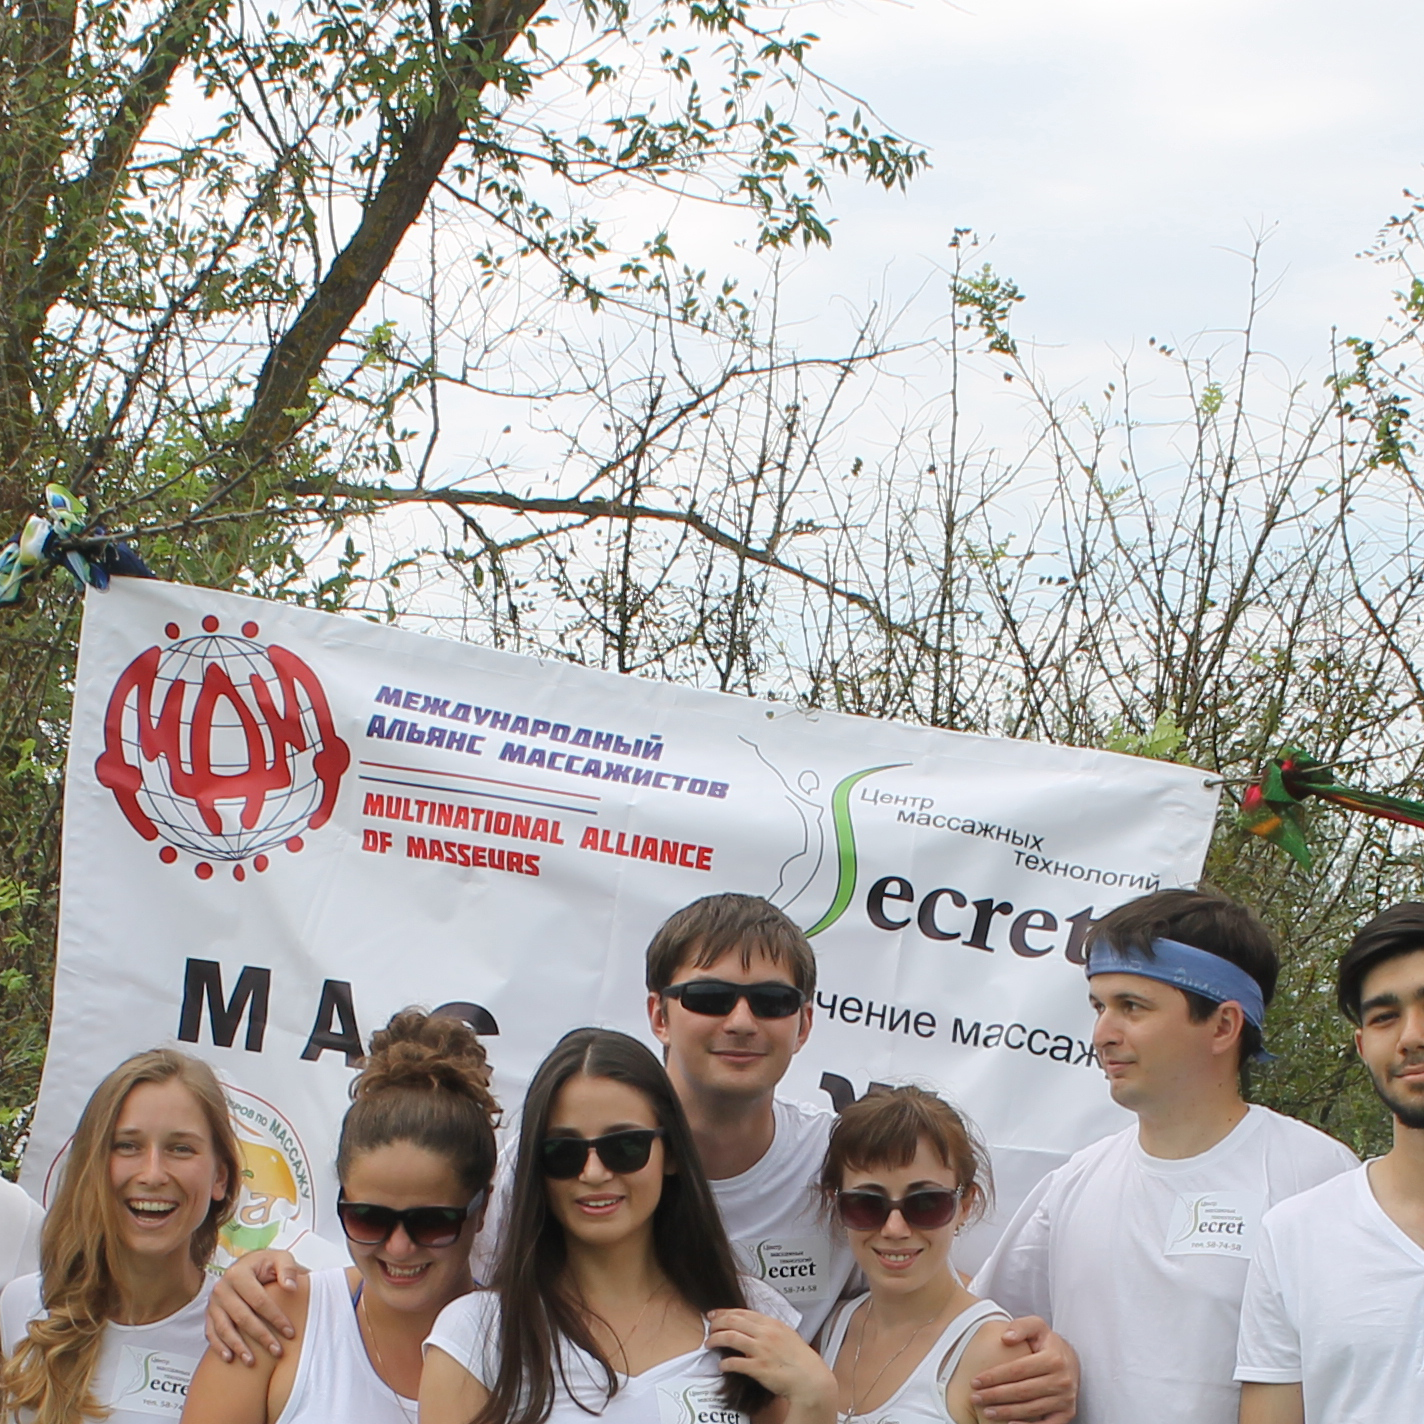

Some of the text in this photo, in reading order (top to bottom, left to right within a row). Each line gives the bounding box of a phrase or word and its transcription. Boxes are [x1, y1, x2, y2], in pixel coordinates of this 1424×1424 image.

[374, 685, 664, 761] МЕЖДУНАРОДНЫЙ
[366, 714, 729, 799] АЛЬЯНС МАССАЖИСТОВ
[860, 787, 935, 811] Центр
[362, 828, 541, 877] OF MASSEURS
[363, 792, 714, 871] MULTINATIONAL ALLIANCE
[896, 809, 1046, 852] массажных
[1013, 849, 1161, 892] технологий
[816, 989, 1105, 1069] чение массаж
[269, 1118, 310, 1199] МАССАЖУ
[160, 1400, 183, 1411] 58-74
